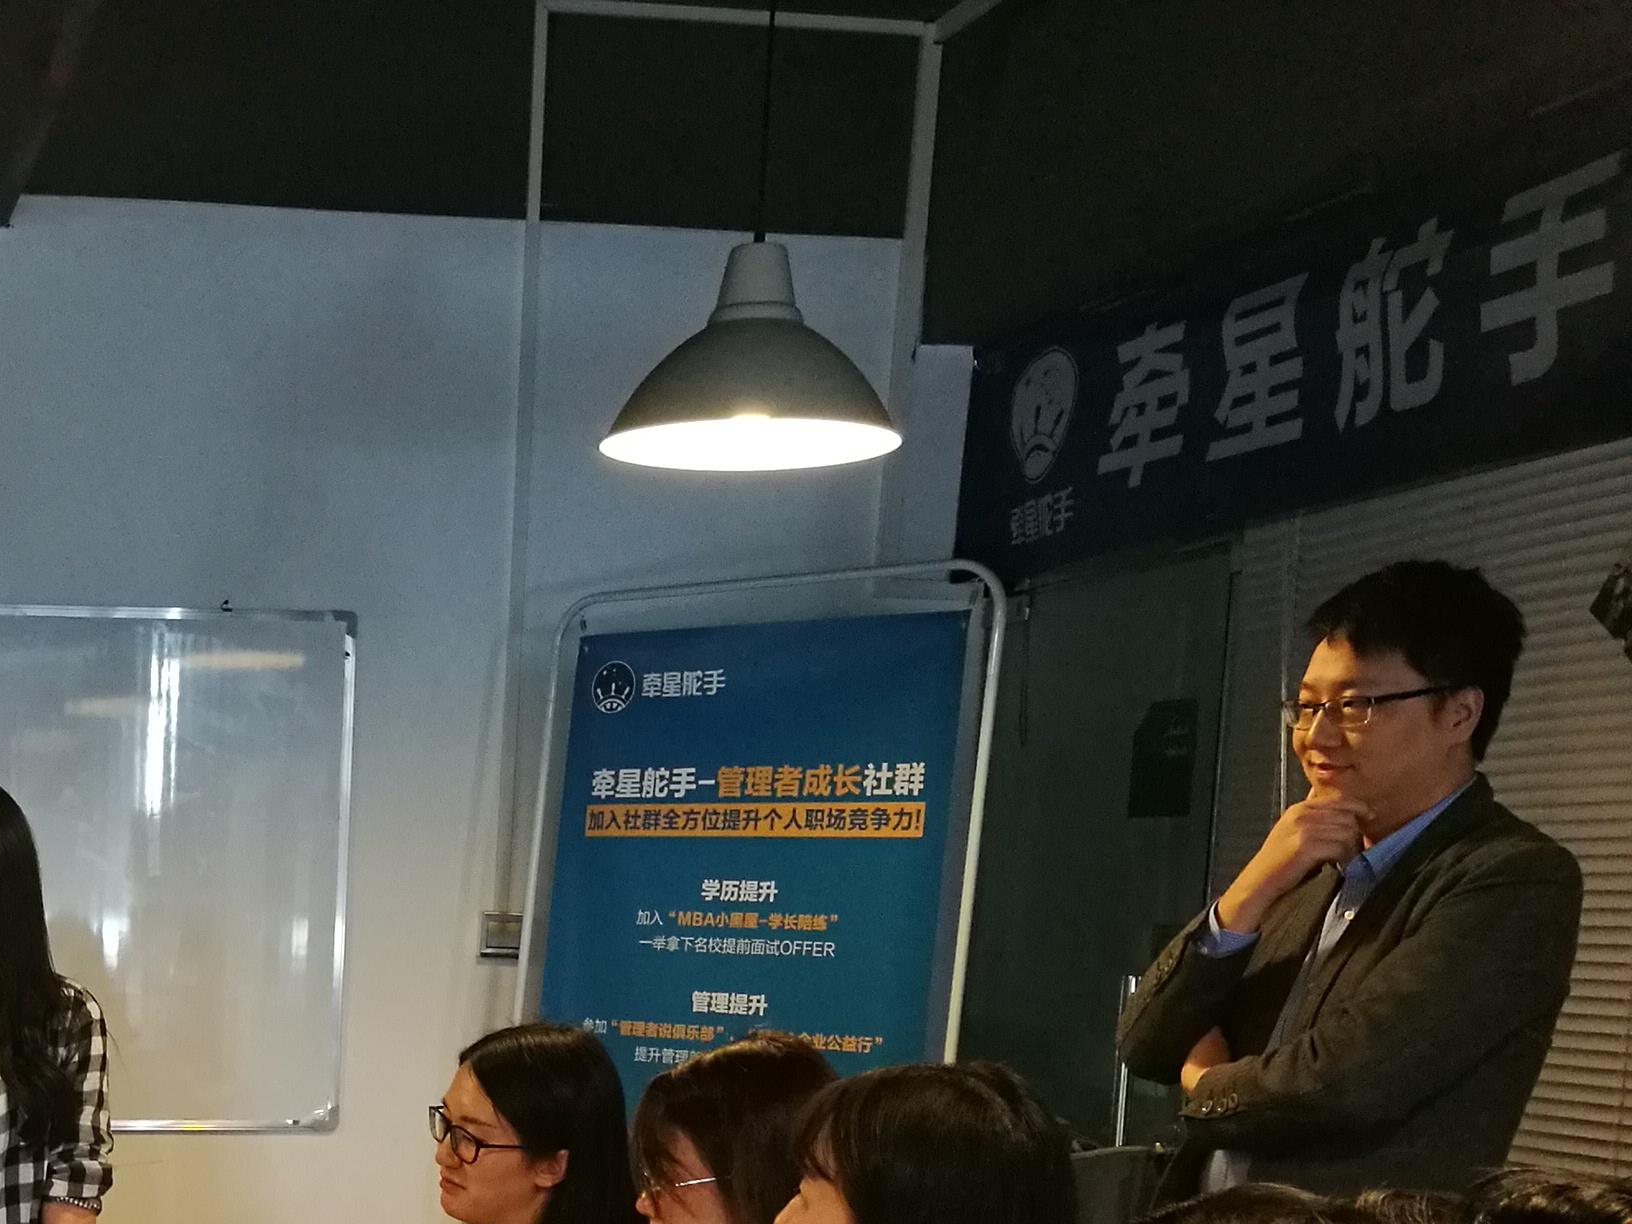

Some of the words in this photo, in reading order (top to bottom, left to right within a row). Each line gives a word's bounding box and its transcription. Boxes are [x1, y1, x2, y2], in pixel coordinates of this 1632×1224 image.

[1097, 149, 1630, 488] 牵星舵手
[641, 669, 727, 698] 牵星舵手
[701, 879, 778, 902] 学历提升
[638, 935, 836, 957] 一举拿下名校提前面试OFFER
[691, 990, 768, 1015] 管理提升
